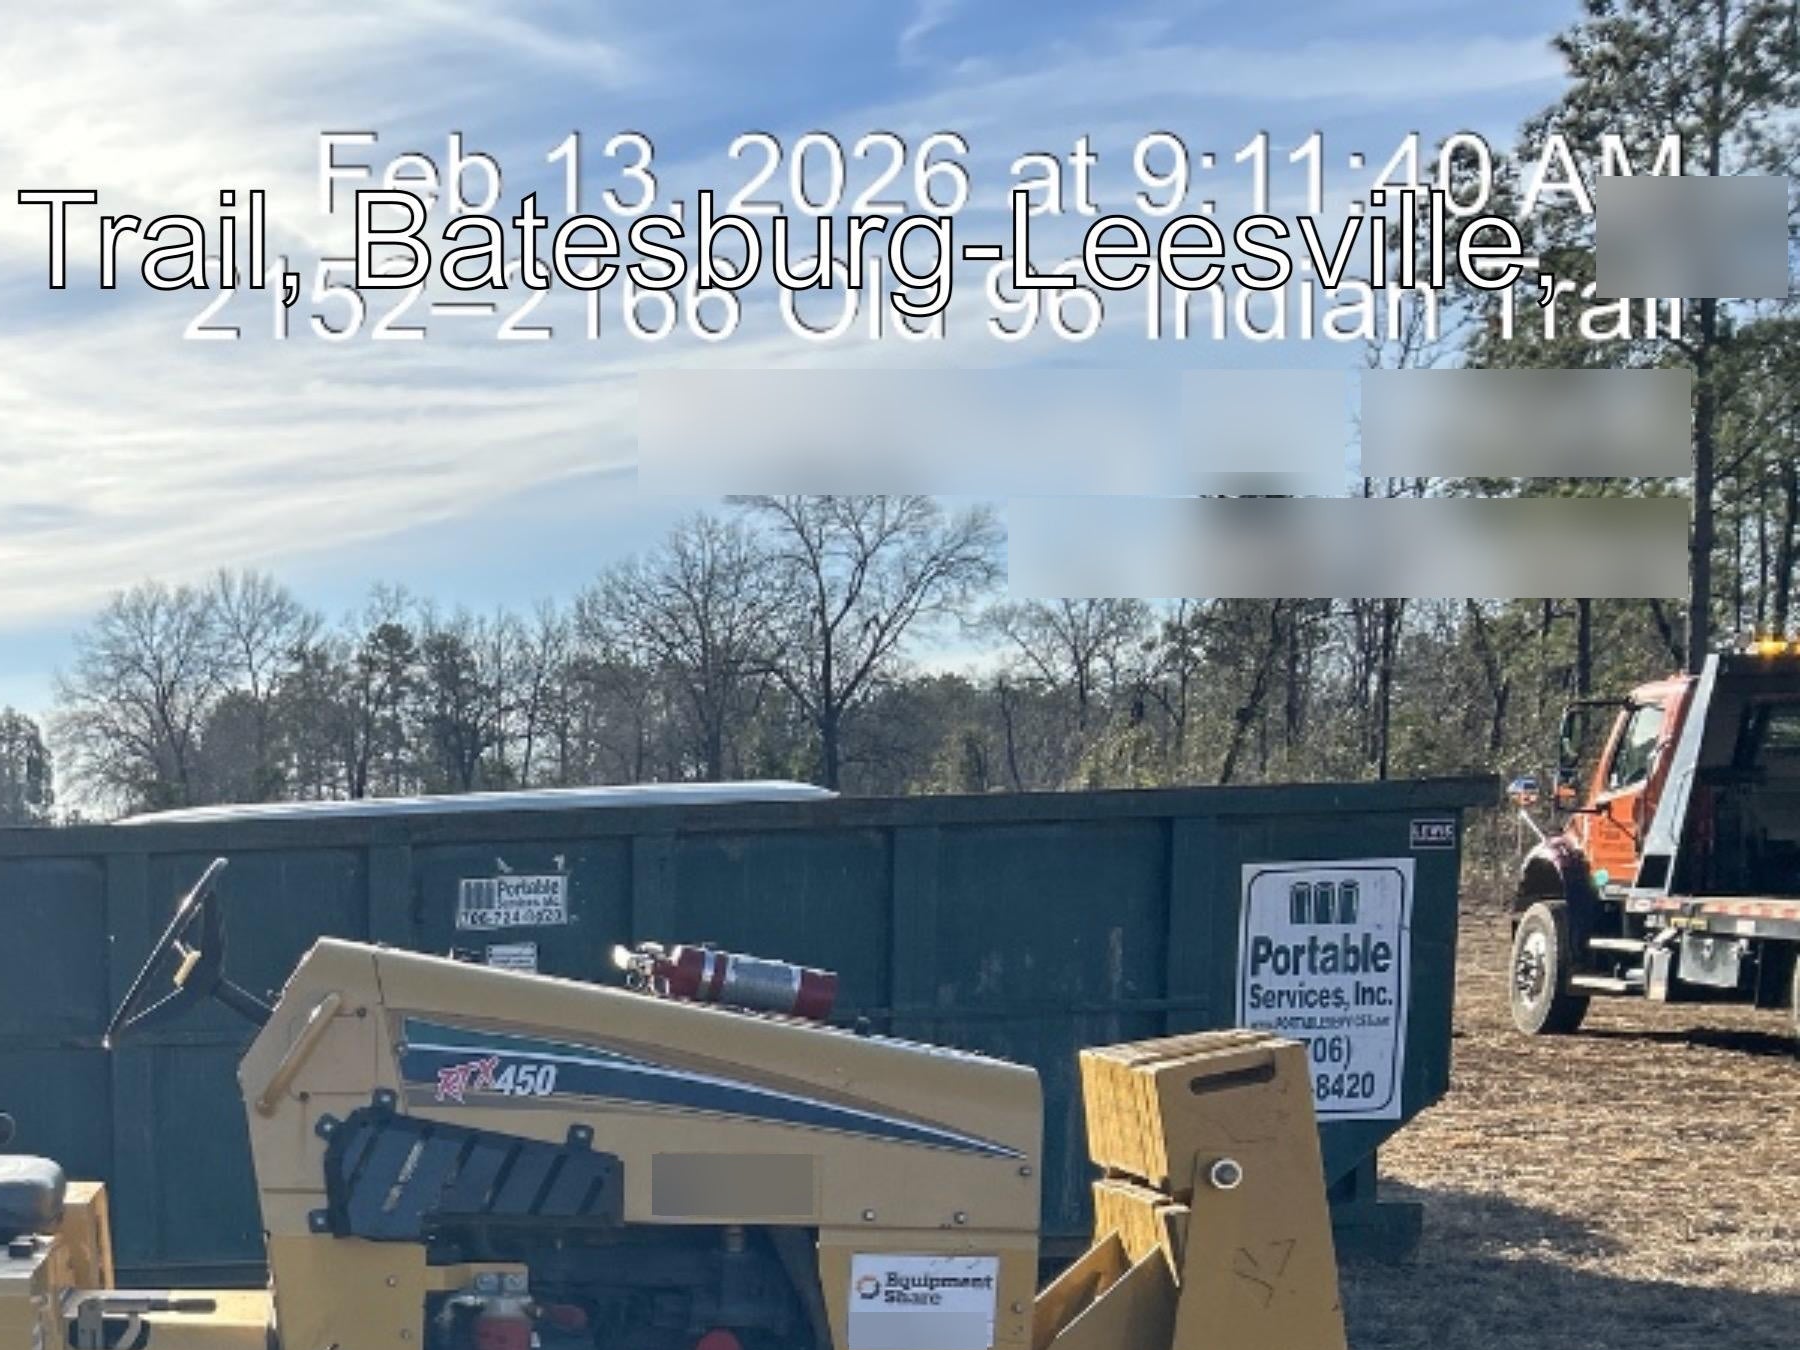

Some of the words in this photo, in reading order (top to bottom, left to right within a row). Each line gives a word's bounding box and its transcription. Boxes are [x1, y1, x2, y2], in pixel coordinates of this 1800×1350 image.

[1250, 932, 1393, 977] Portable
[1249, 980, 1350, 1012] Services,
[1354, 979, 1394, 1007] Inc.
[884, 1271, 994, 1292] Equipment
[884, 1289, 943, 1306] Share
